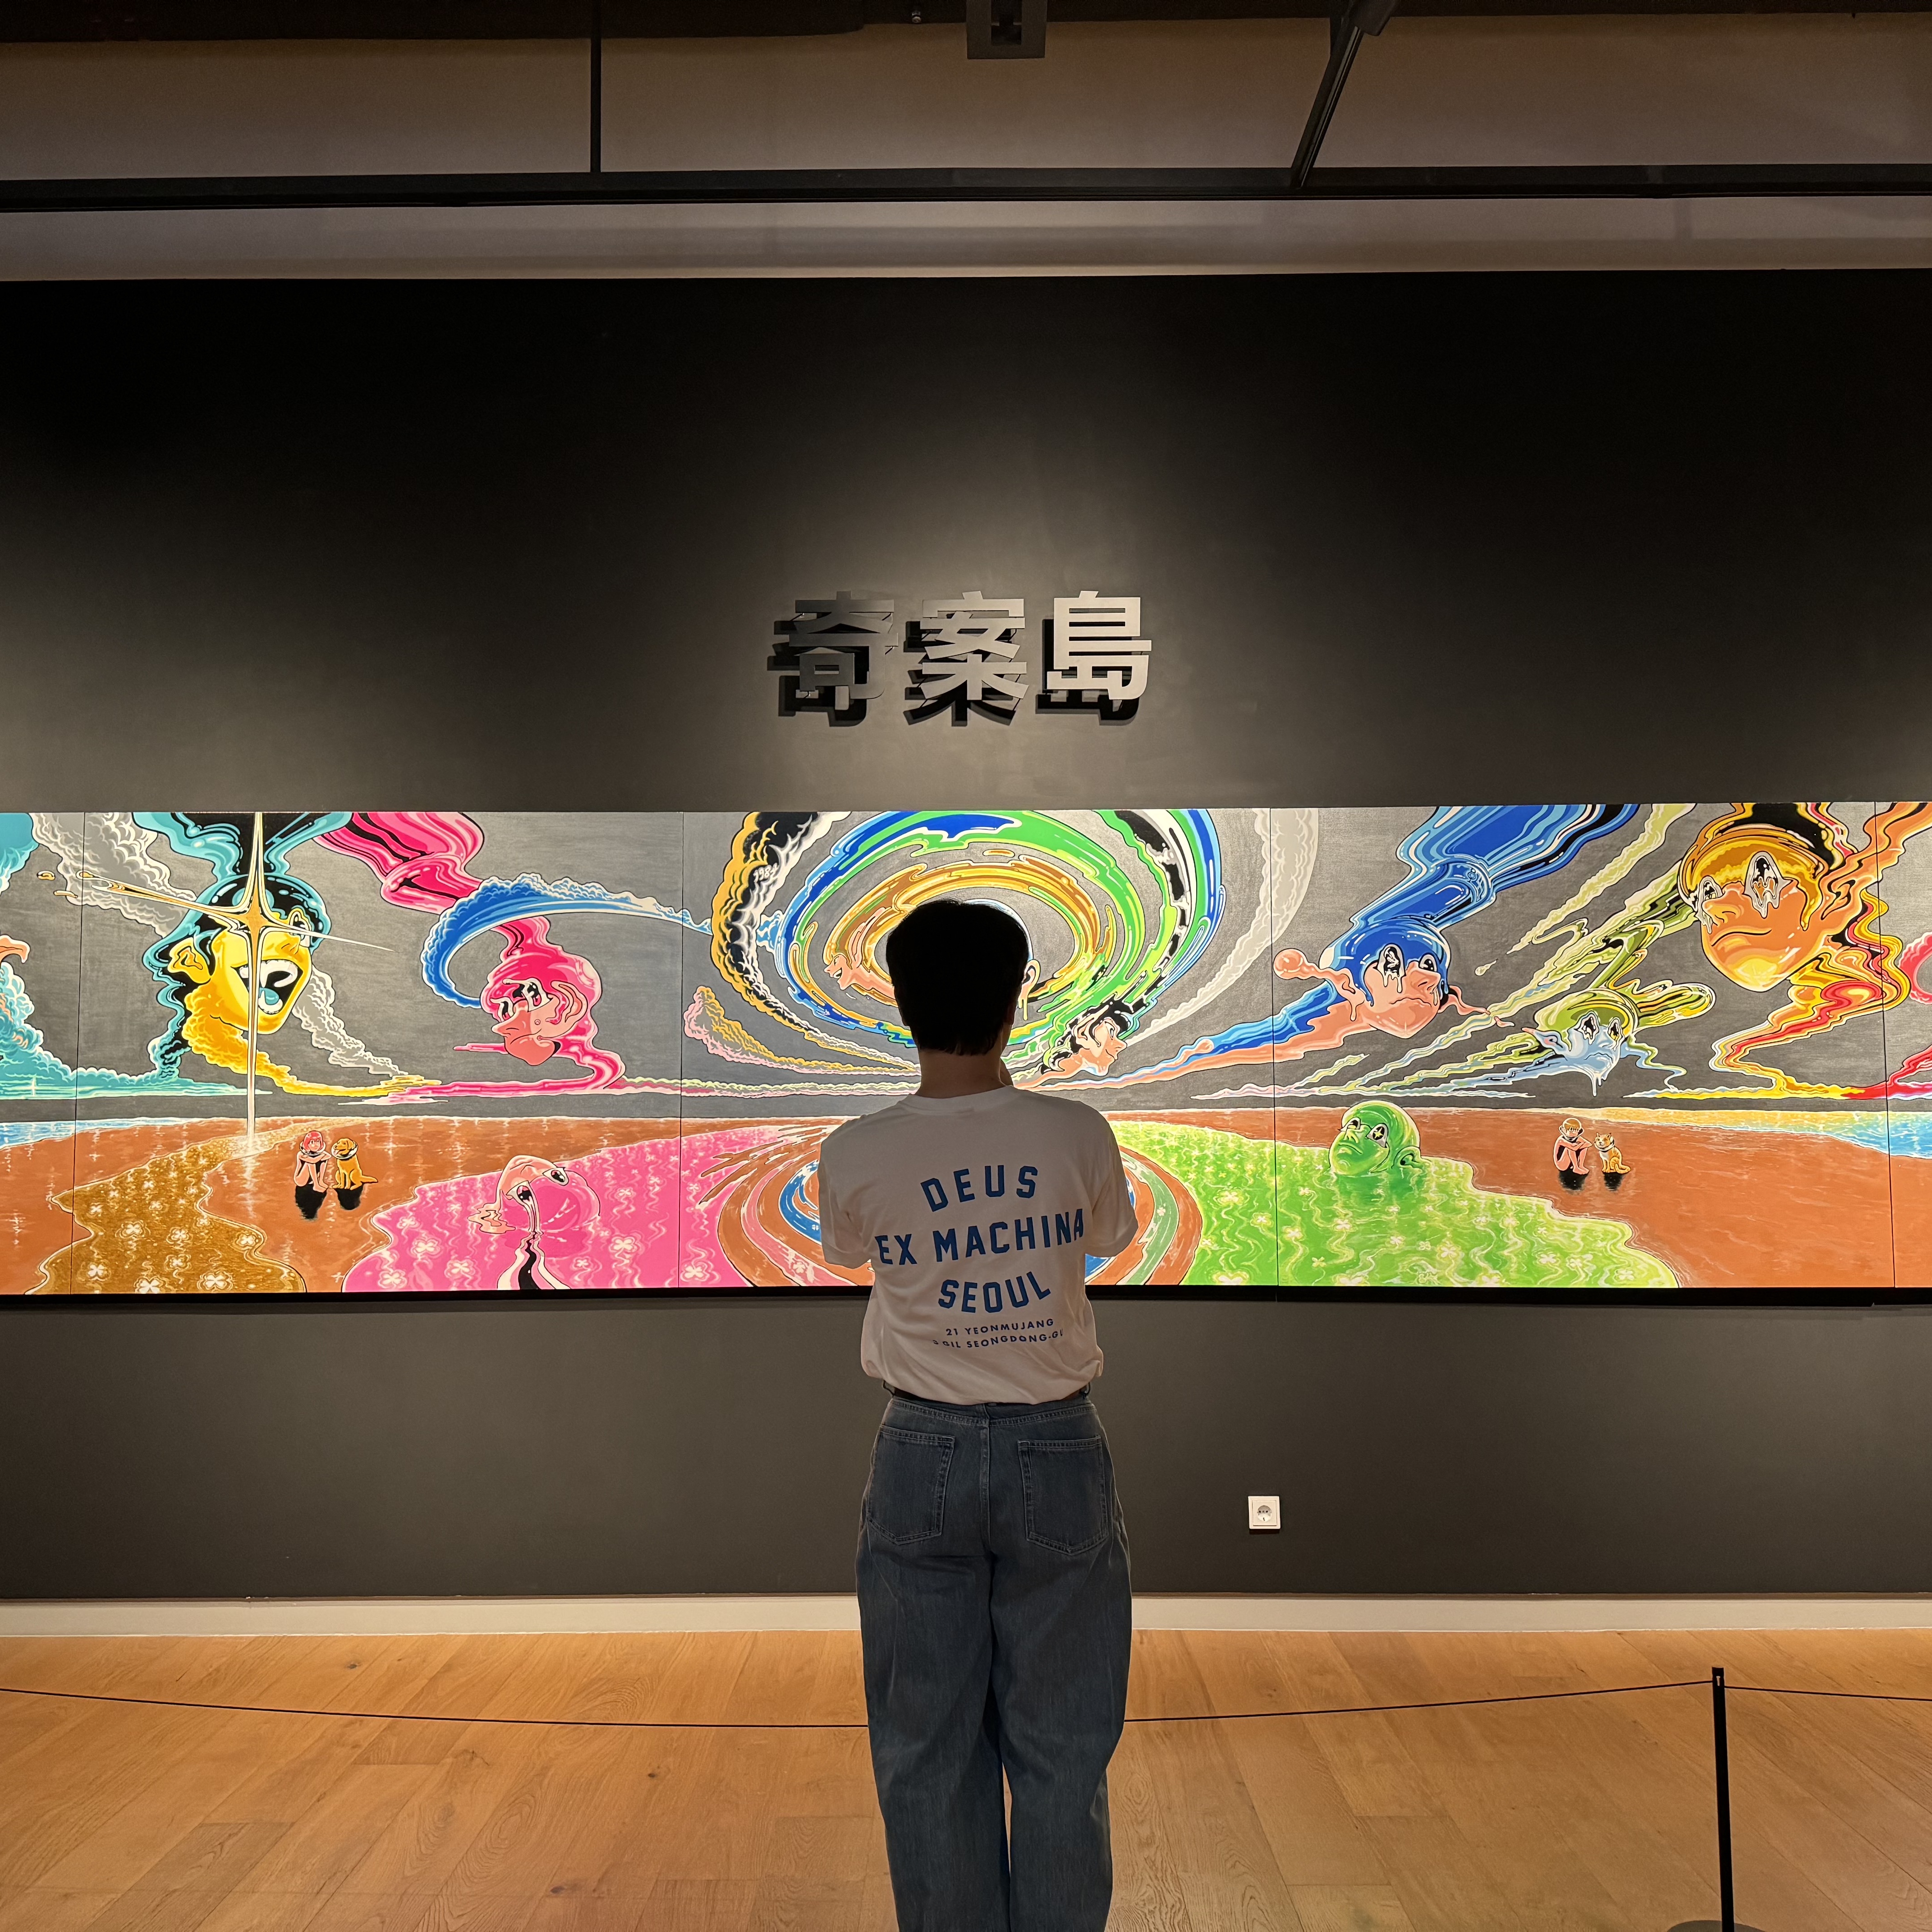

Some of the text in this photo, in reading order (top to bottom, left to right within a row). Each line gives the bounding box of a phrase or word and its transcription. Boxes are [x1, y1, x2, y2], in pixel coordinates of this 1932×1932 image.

[788, 590, 1152, 700] 奇案島
[753, 862, 779, 881] 1984
[920, 1165, 1038, 1212] DEUS
[874, 1208, 1084, 1265] EX MACHINA
[938, 1271, 1051, 1313] SEOUL
[964, 1318, 1054, 1335] YEONMUJANG
